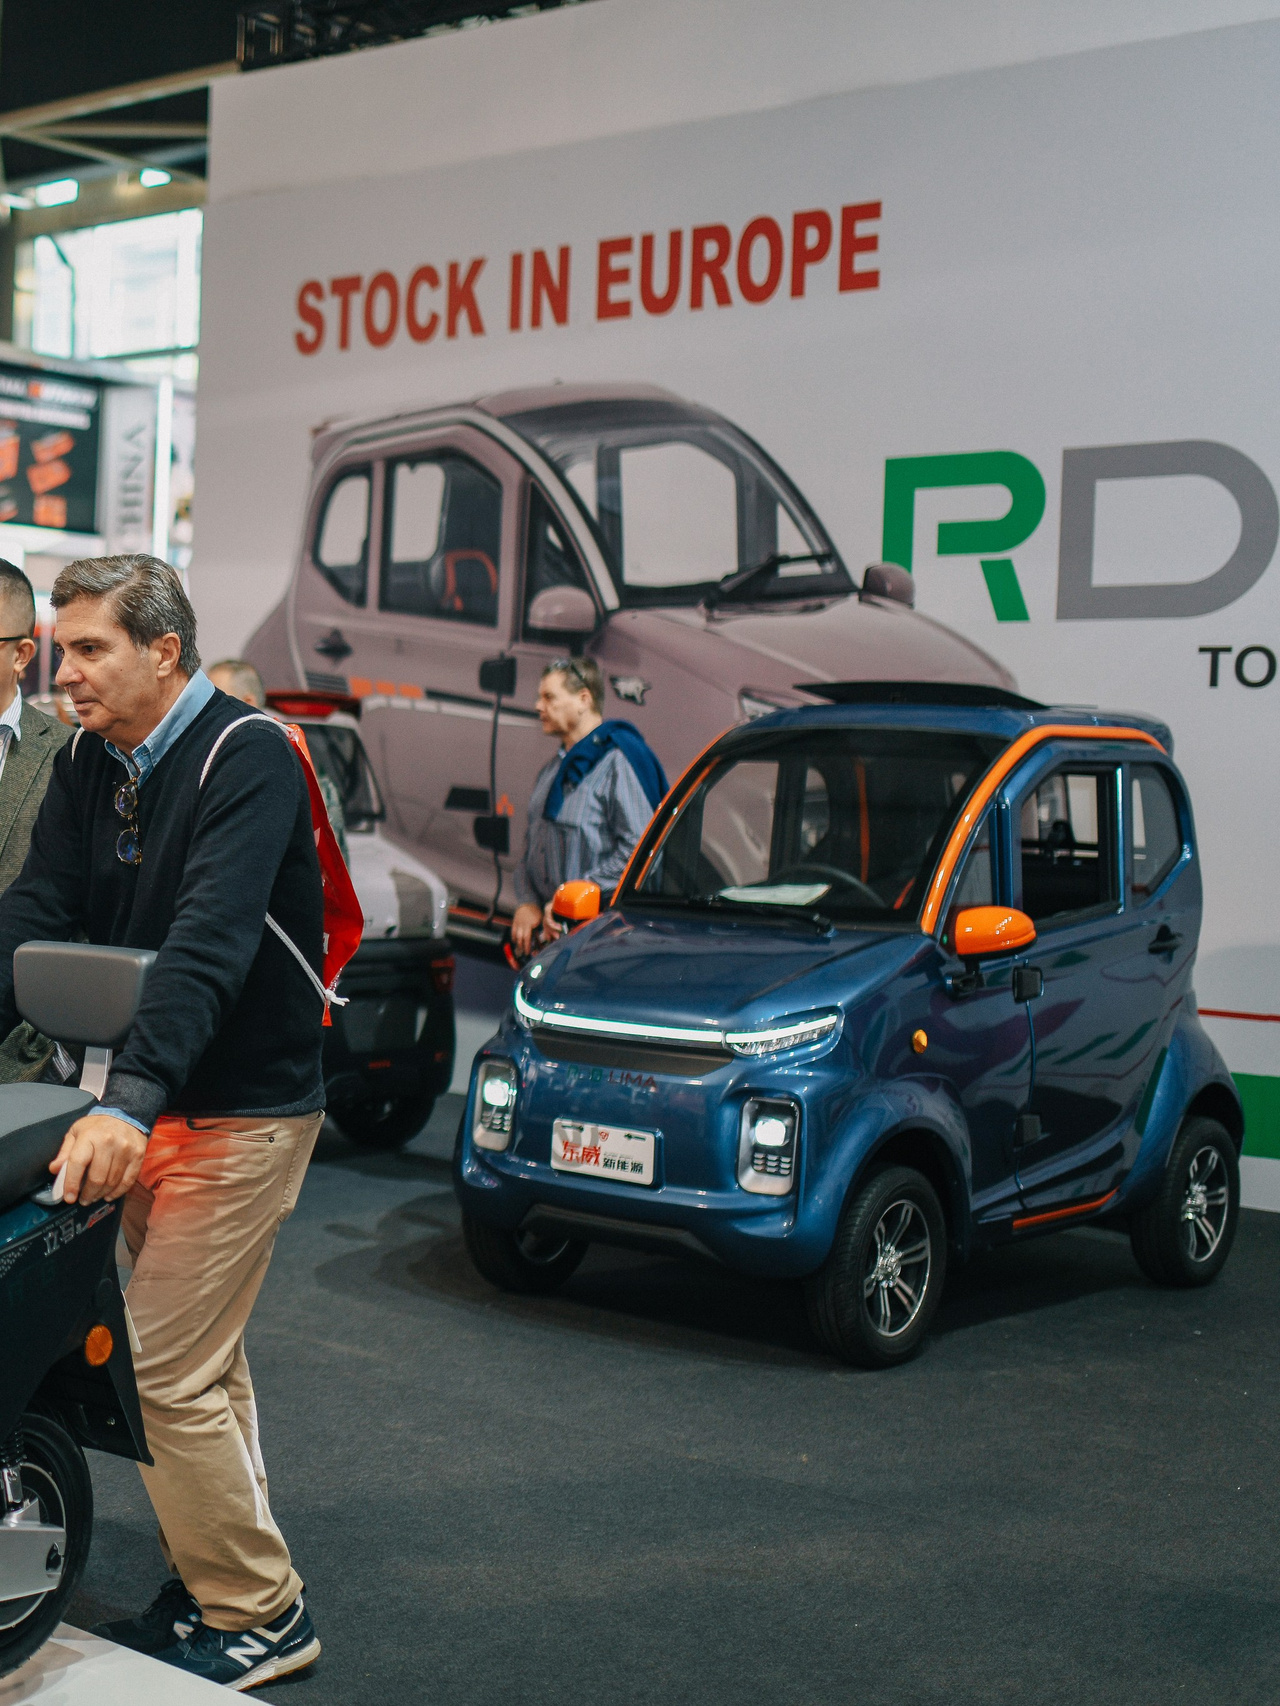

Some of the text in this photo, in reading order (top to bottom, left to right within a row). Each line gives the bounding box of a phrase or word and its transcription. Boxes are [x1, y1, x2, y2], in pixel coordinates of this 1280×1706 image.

[294, 200, 882, 356] STOCK IN EUROPE
[1197, 645, 1277, 689] TO
[607, 1070, 658, 1089] LIMA
[602, 1157, 644, 1175] 新能源
[224, 1633, 269, 1669] N
